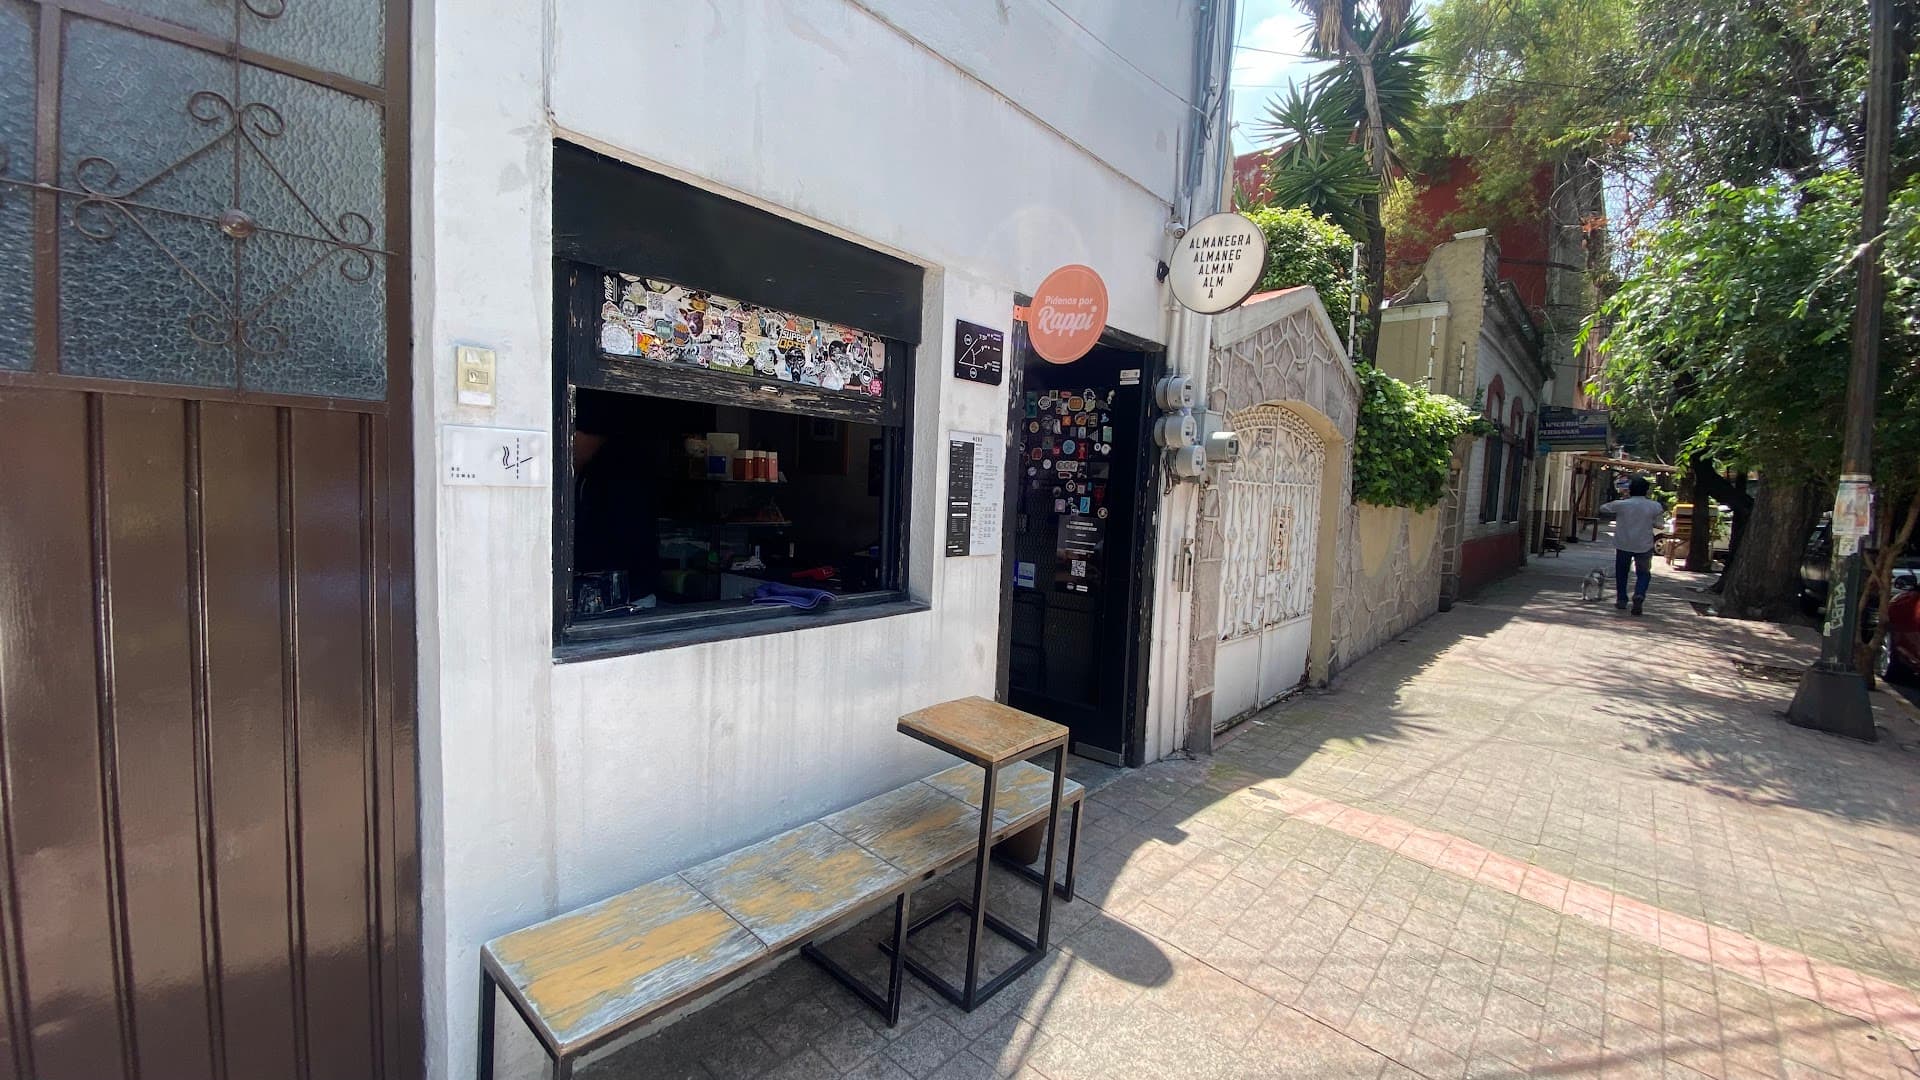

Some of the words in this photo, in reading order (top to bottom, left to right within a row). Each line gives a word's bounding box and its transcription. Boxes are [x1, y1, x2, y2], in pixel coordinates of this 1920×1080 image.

[1189, 233, 1251, 249] ALMANEGRA
[1193, 249, 1242, 263] ALMANEG
[1198, 262, 1234, 275] ALMAN
[1202, 276, 1224, 288] ALM
[1208, 288, 1214, 299] A
[1078, 297, 1094, 308] por
[1038, 305, 1098, 337] Rappi
